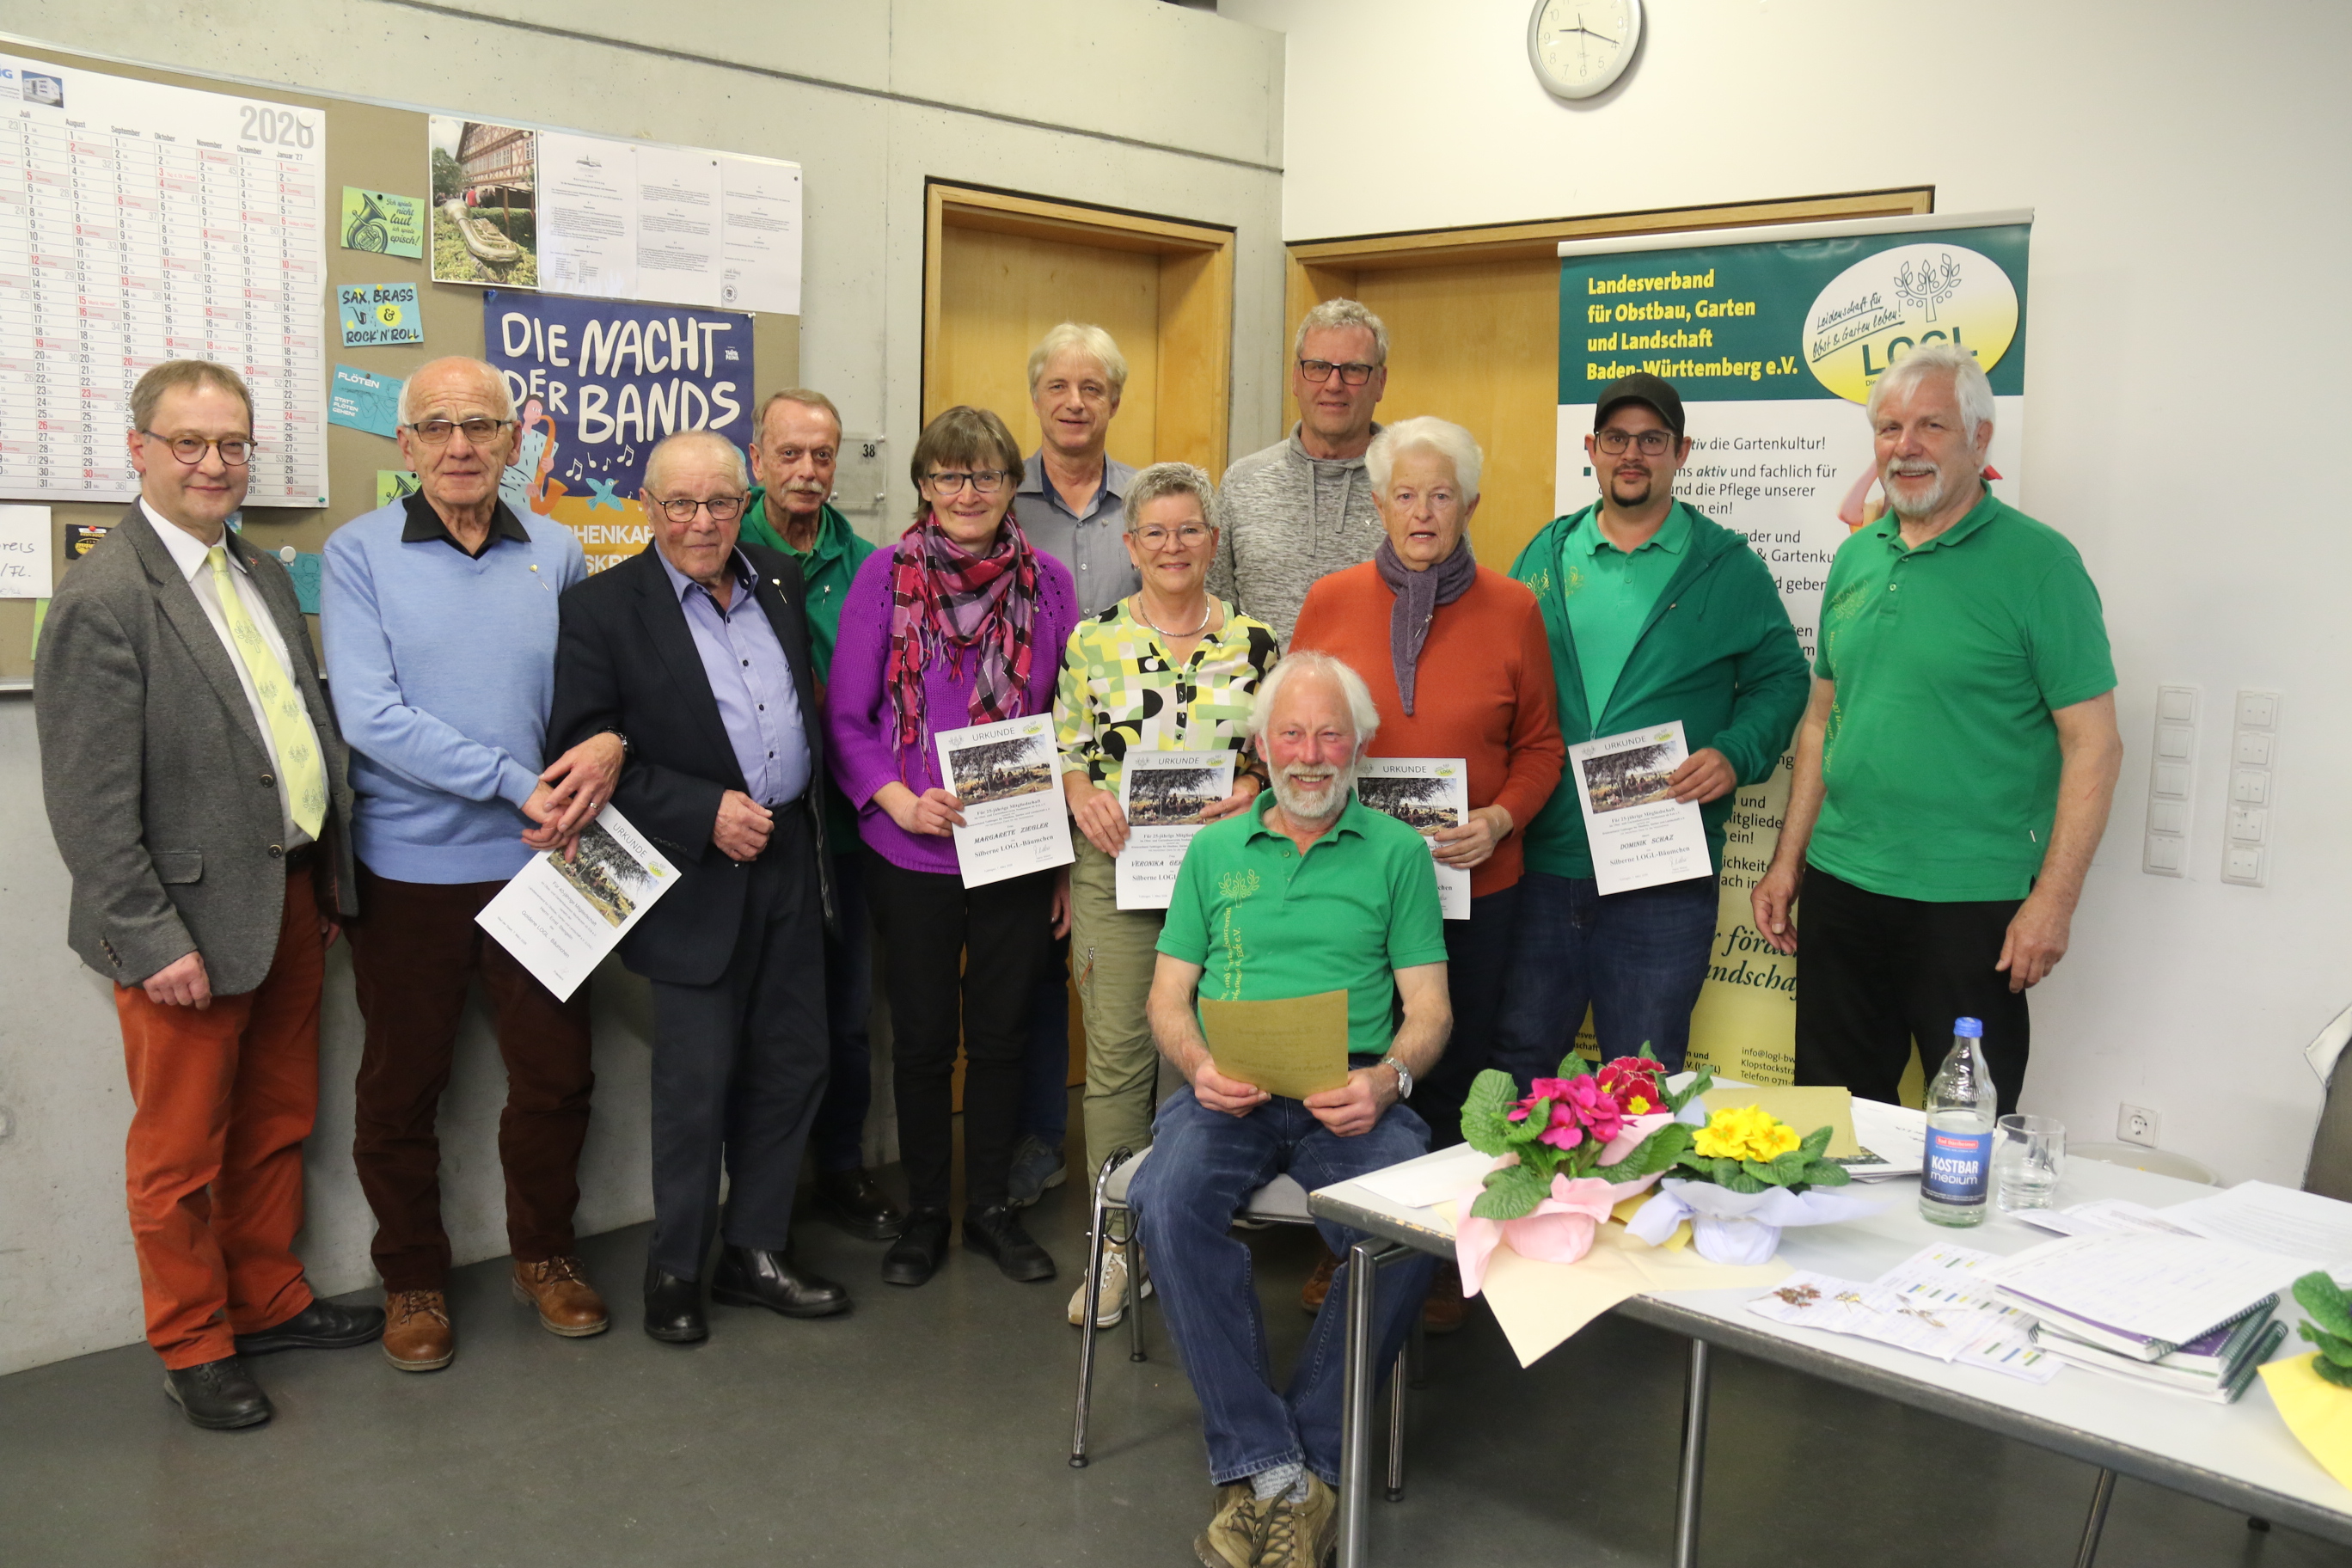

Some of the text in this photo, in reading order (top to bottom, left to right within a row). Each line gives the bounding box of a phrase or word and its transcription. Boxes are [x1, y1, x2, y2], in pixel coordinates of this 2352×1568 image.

[1550, 9, 1559, 21] 10
[1543, 32, 1551, 45] 9
[1549, 52, 1557, 64] 8
[1597, 56, 1605, 69] 5
[1563, 64, 1569, 77] 7
[1579, 65, 1587, 77] 6
[19, 110, 31, 119] Juli
[65, 119, 86, 129] August
[240, 105, 314, 149] 2026
[111, 126, 140, 137] September
[154, 132, 175, 143] Oktober
[196, 139, 223, 150] November
[236, 145, 262, 156] Dezember
[276, 151, 293, 160] Januar
[396, 207, 414, 217] nicht
[390, 213, 412, 226] laut
[390, 235, 420, 247] episch!
[31, 255, 40, 265] 12
[32, 267, 40, 276] 13
[121, 277, 129, 285] 13
[1588, 268, 1715, 296] Landesverband
[244, 289, 251, 297] 13
[342, 288, 413, 304] SAX, BRASS
[79, 307, 87, 316] 16
[205, 308, 212, 316] 15
[383, 309, 395, 322] &
[1588, 298, 1756, 323] für Obstbau, Garten
[1816, 297, 1869, 331] Leidenschaft
[166, 338, 173, 346] 18
[284, 336, 291, 345] 17
[346, 328, 420, 343] ROCK'N'ROLL
[1587, 328, 1713, 352] und Landschaft
[501, 312, 732, 378] DIE NACHT
[1812, 338, 1832, 359] Obst
[1833, 333, 1841, 346] &
[35, 351, 45, 359] 20
[123, 357, 132, 366] 20
[245, 365, 254, 375] 20
[1587, 356, 1798, 382] Baden-Württemberg e.V.
[36, 374, 46, 383] 22
[338, 371, 380, 389] FLÖTEN
[82, 389, 91, 397] 23
[334, 396, 354, 405] STATT
[334, 401, 358, 412] FLÖTEN
[503, 369, 741, 444] DER BANDS
[285, 412, 292, 420] 24
[332, 407, 356, 417] GEHEN!
[38, 421, 47, 430] 26
[1690, 436, 1826, 450] tiv die Gartenkultur!
[862, 444, 875, 457] 38
[39, 468, 48, 476] 30
[83, 469, 93, 478] 30
[1696, 465, 1728, 478] aktiv
[1730, 464, 1756, 478] und
[1760, 464, 1812, 478] fachlich
[1816, 464, 1837, 478] für
[286, 487, 293, 495] 31
[1695, 483, 1716, 496] die
[1719, 483, 1761, 500] Pflege
[1764, 486, 1816, 497] unserer
[1708, 501, 1733, 515] ein!
[1775, 530, 1801, 543] und
[1756, 548, 1835, 563] & Gartenku
[972, 727, 1015, 741] URKUNDE
[1605, 733, 1646, 751] URKUNDE
[1741, 796, 1766, 809] und
[974, 822, 1049, 844] MARGARETE ZIEGLER
[1730, 830, 1754, 844] ein!
[613, 823, 647, 858] URKUNDE
[974, 835, 1054, 858] Silberne LOGL-Bäumchen
[1620, 834, 1674, 850] DOMINIK SCHAZ
[1609, 847, 1690, 867] Silberne LOGL-Bäumchen
[521, 910, 538, 928] Goldene
[536, 925, 549, 939] LOGL
[550, 938, 570, 959] Bäumchen
[1741, 1059, 1795, 1075] Klopstockstra
[1741, 1070, 1769, 1082] Telefon
[1932, 1155, 1979, 1174] KOSTBAR
